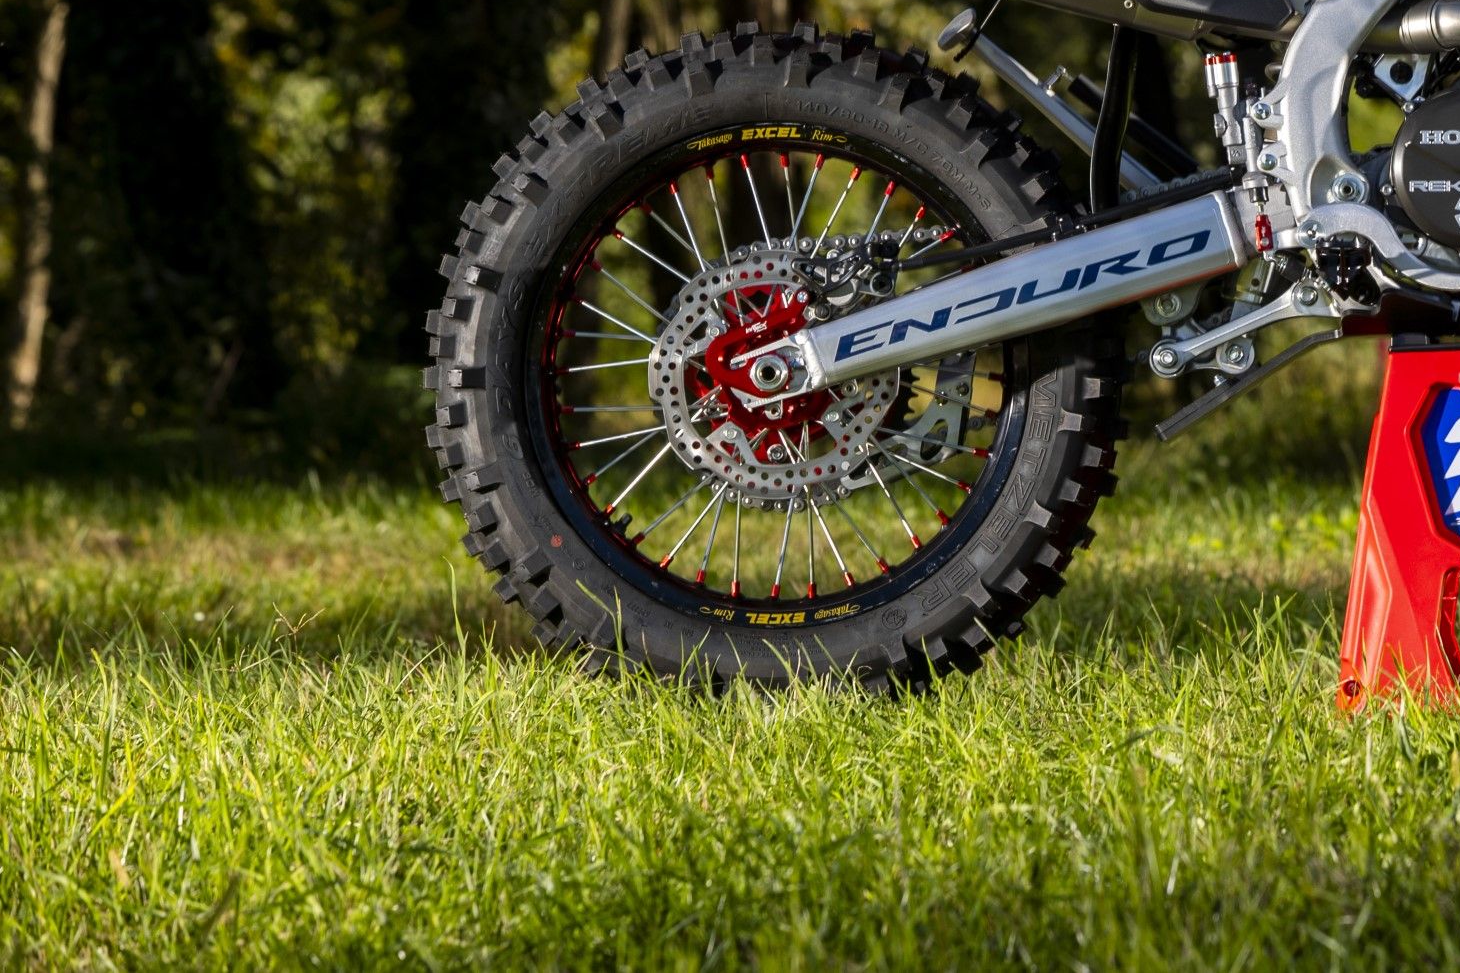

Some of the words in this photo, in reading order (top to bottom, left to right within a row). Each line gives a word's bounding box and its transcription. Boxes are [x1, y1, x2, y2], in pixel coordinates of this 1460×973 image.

[690, 133, 733, 150] Takasago
[742, 127, 801, 140] EXCEL
[812, 129, 834, 142] Rim
[834, 229, 1212, 363] ENDURO
[912, 372, 1061, 615] METZELER
[713, 609, 735, 622] Rim
[746, 612, 806, 625] EXCEL
[814, 603, 854, 621] Takasago
